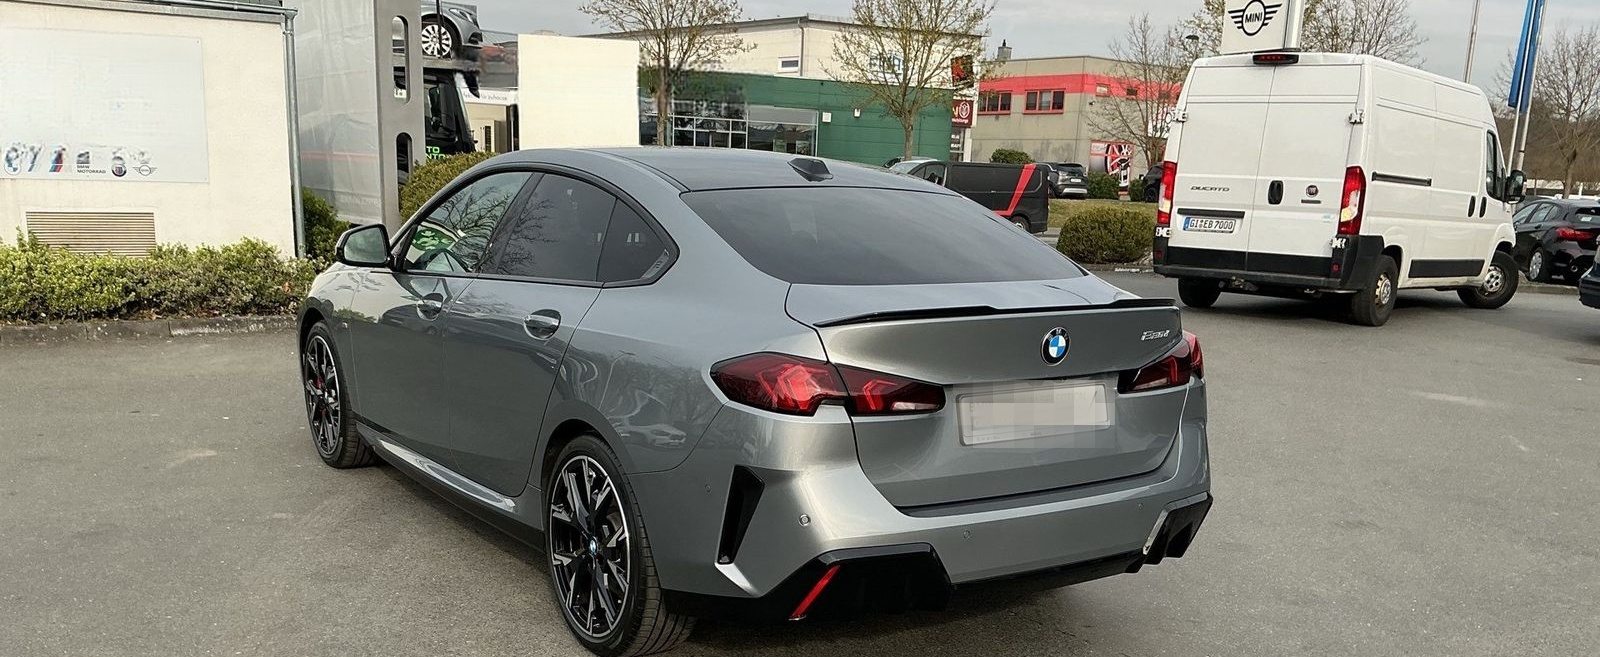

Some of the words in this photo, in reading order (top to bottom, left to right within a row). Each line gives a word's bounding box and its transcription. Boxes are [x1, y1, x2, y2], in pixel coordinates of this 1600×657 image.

[1245, 12, 1263, 23] MINI
[1190, 219, 1200, 228] GI
[1203, 220, 1214, 229] EB
[1214, 220, 1234, 230] 7000
